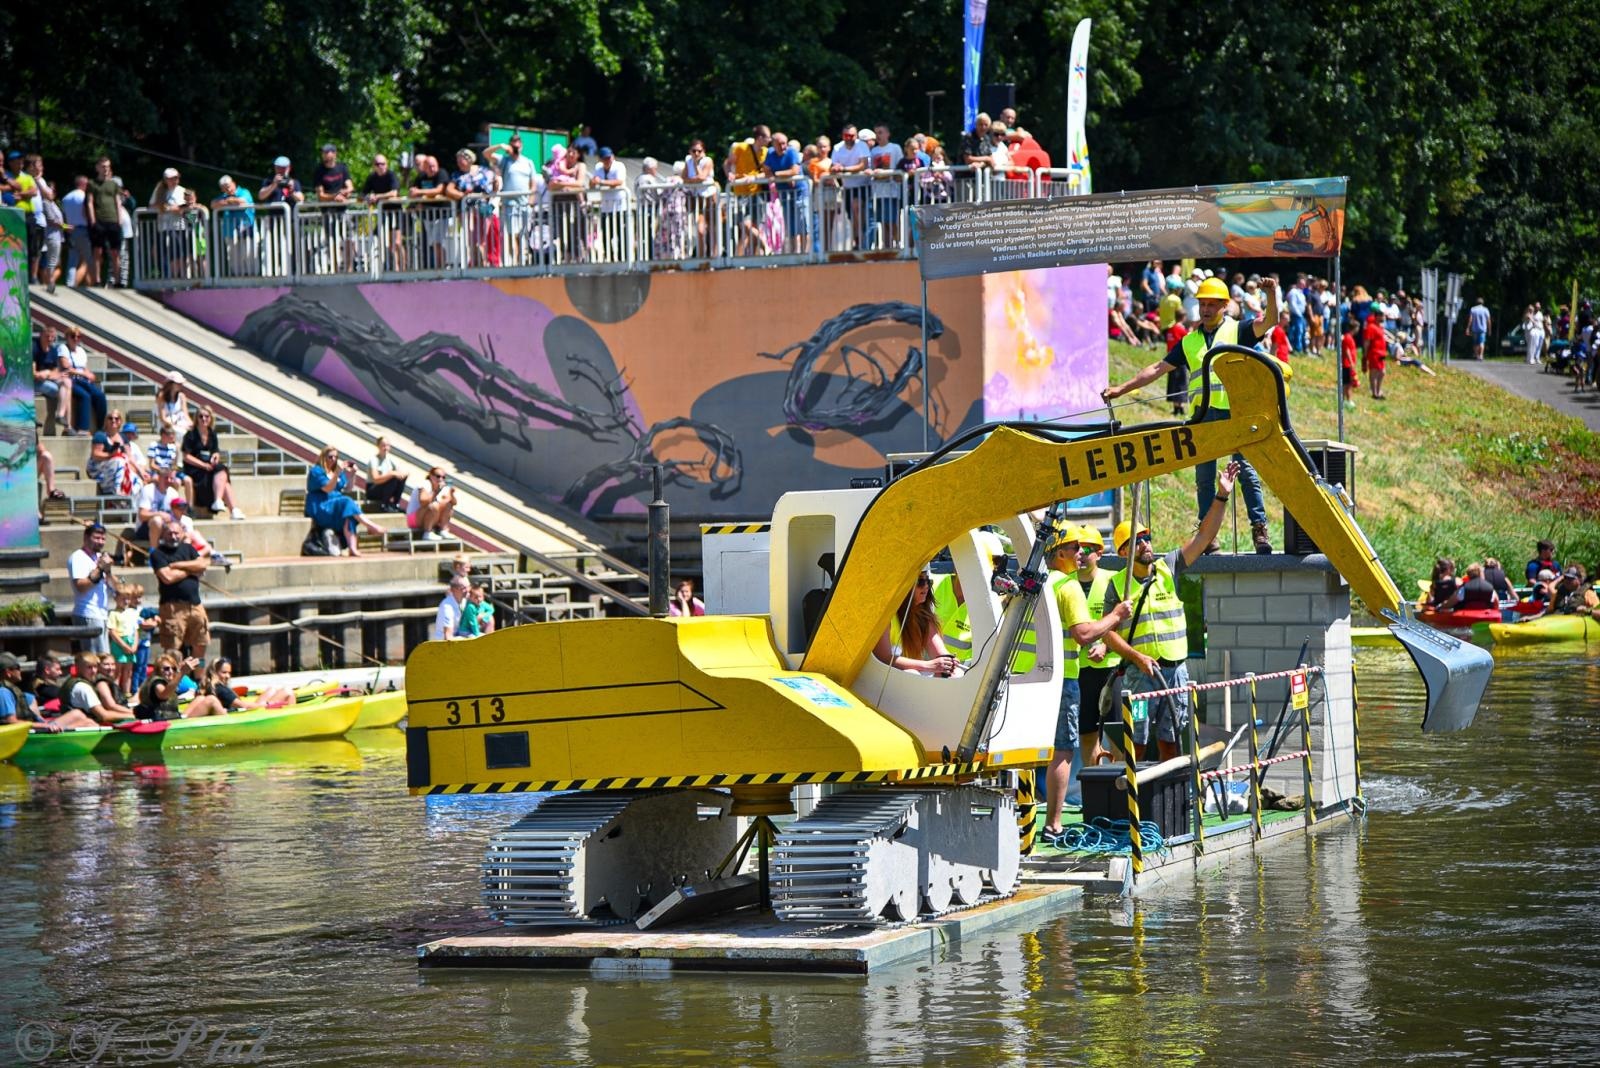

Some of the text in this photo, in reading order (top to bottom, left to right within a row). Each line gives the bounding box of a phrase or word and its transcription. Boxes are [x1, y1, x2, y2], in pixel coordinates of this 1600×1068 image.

[938, 223, 961, 232] Wtedy
[971, 220, 993, 229] chwilę
[1075, 212, 1111, 220] zamykamy
[1135, 207, 1176, 216] sprawdzamy
[974, 229, 1004, 238] potrzeba
[1005, 226, 1037, 235] rozsądnej
[1130, 216, 1158, 224] kolejnej
[930, 242, 944, 250] Dziś
[953, 241, 975, 249] stronę
[1105, 226, 1128, 235] spokój
[1138, 224, 1165, 233] wszyscy
[1066, 237, 1094, 246] Chrobry
[1057, 248, 1078, 257] Dolny
[1079, 246, 1098, 254] przed
[1099, 245, 1112, 253] falą
[1059, 427, 1197, 487] LEBER
[446, 697, 505, 725] 313
